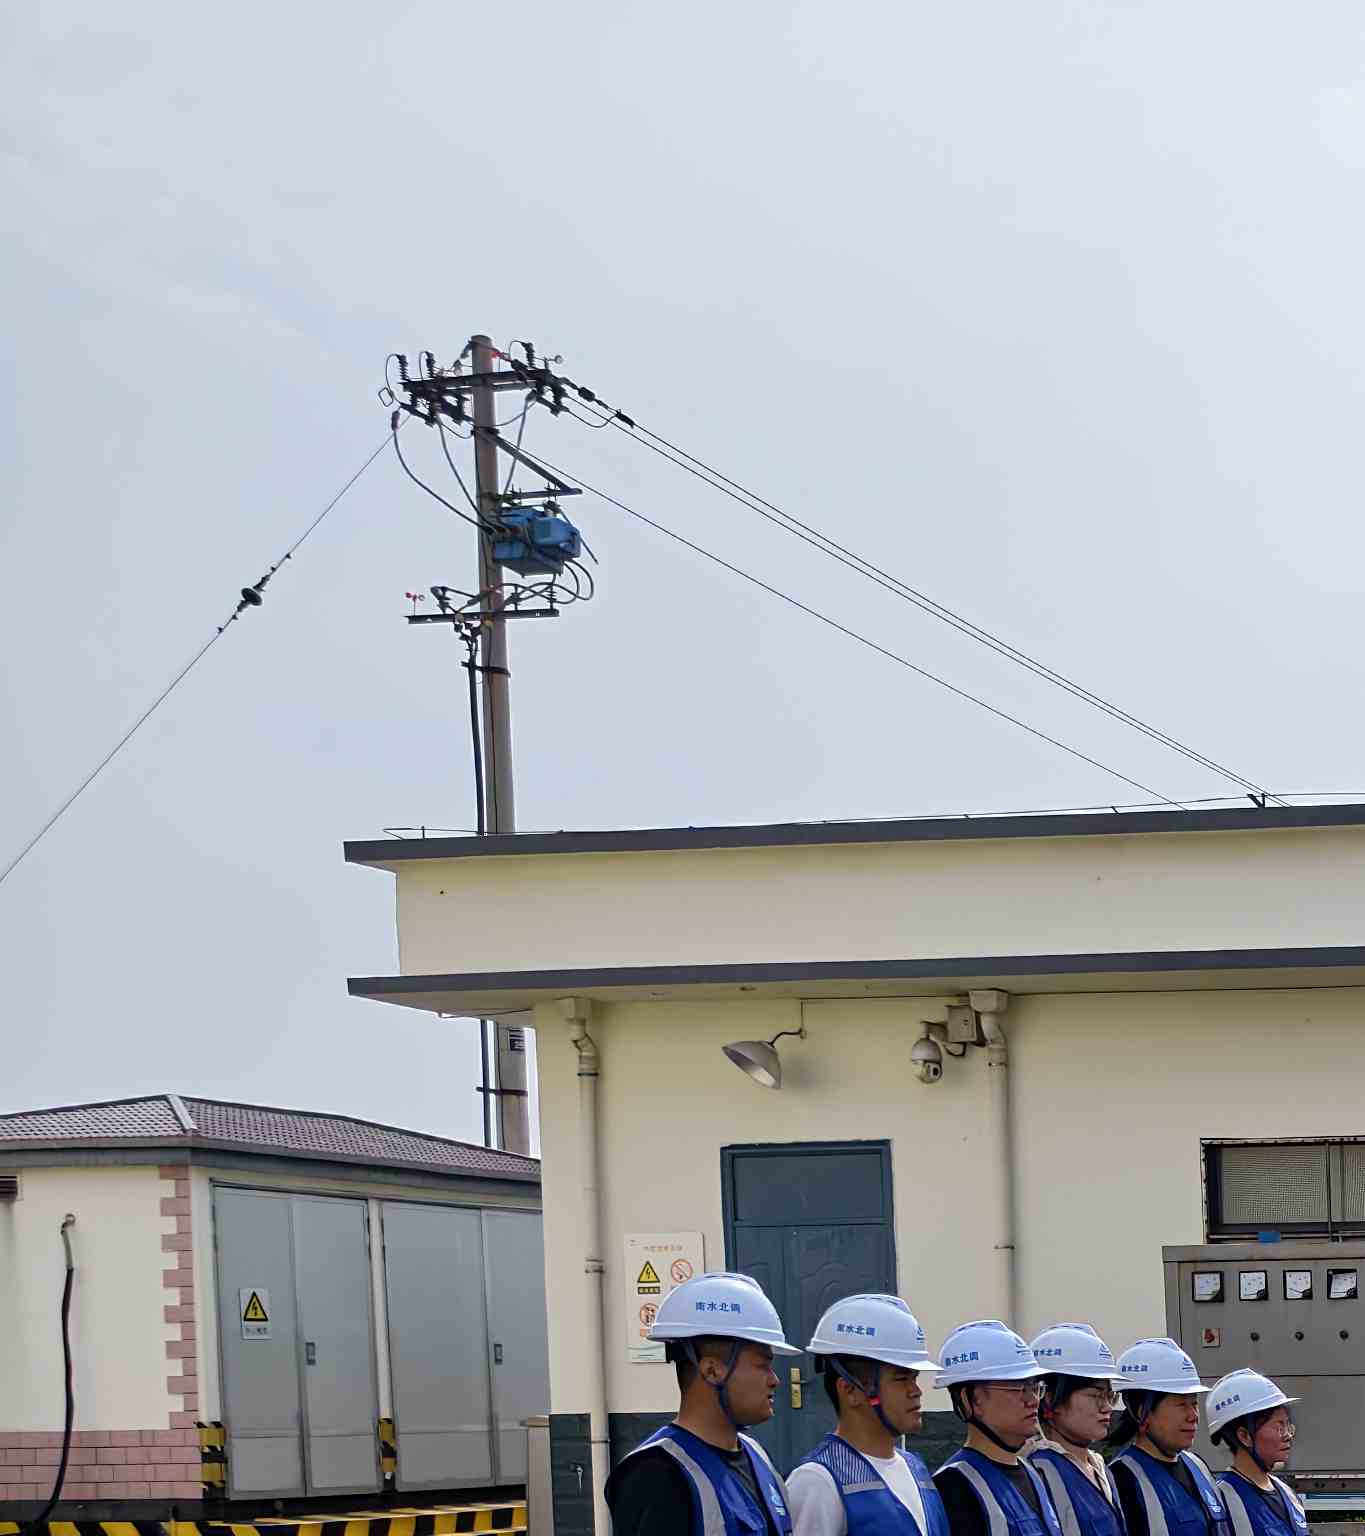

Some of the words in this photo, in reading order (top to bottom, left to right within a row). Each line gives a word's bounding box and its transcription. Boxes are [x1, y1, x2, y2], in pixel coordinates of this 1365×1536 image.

[695, 1301, 742, 1313] 南水北调
[836, 1323, 876, 1336] 南水北调
[944, 1351, 979, 1367] 南水北调
